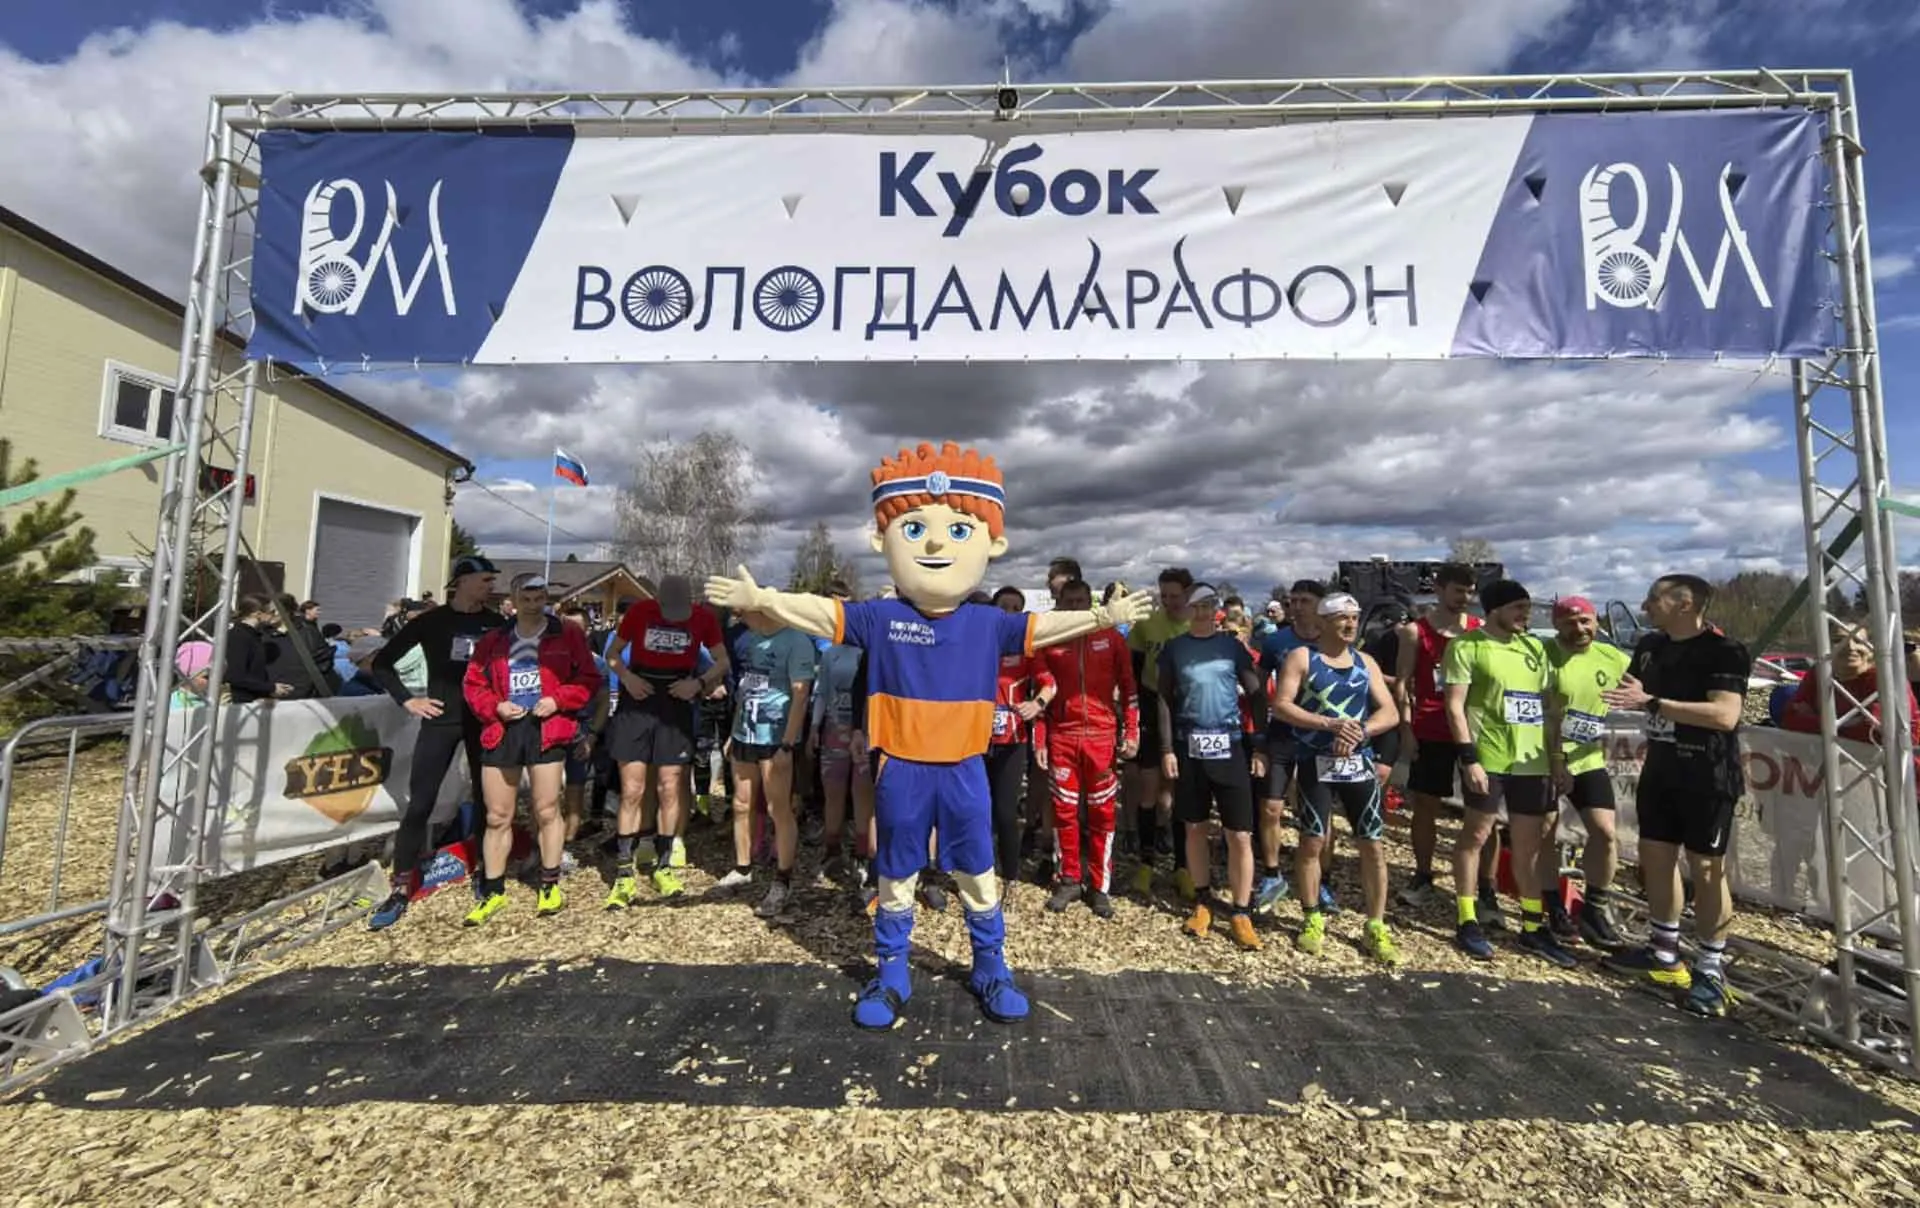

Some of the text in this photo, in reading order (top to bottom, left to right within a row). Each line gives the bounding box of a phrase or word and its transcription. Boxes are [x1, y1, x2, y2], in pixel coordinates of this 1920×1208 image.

[879, 142, 1160, 238] Кубок
[573, 235, 1419, 341] ВОЛОГДАМАРАФОН
[512, 672, 539, 688] 107
